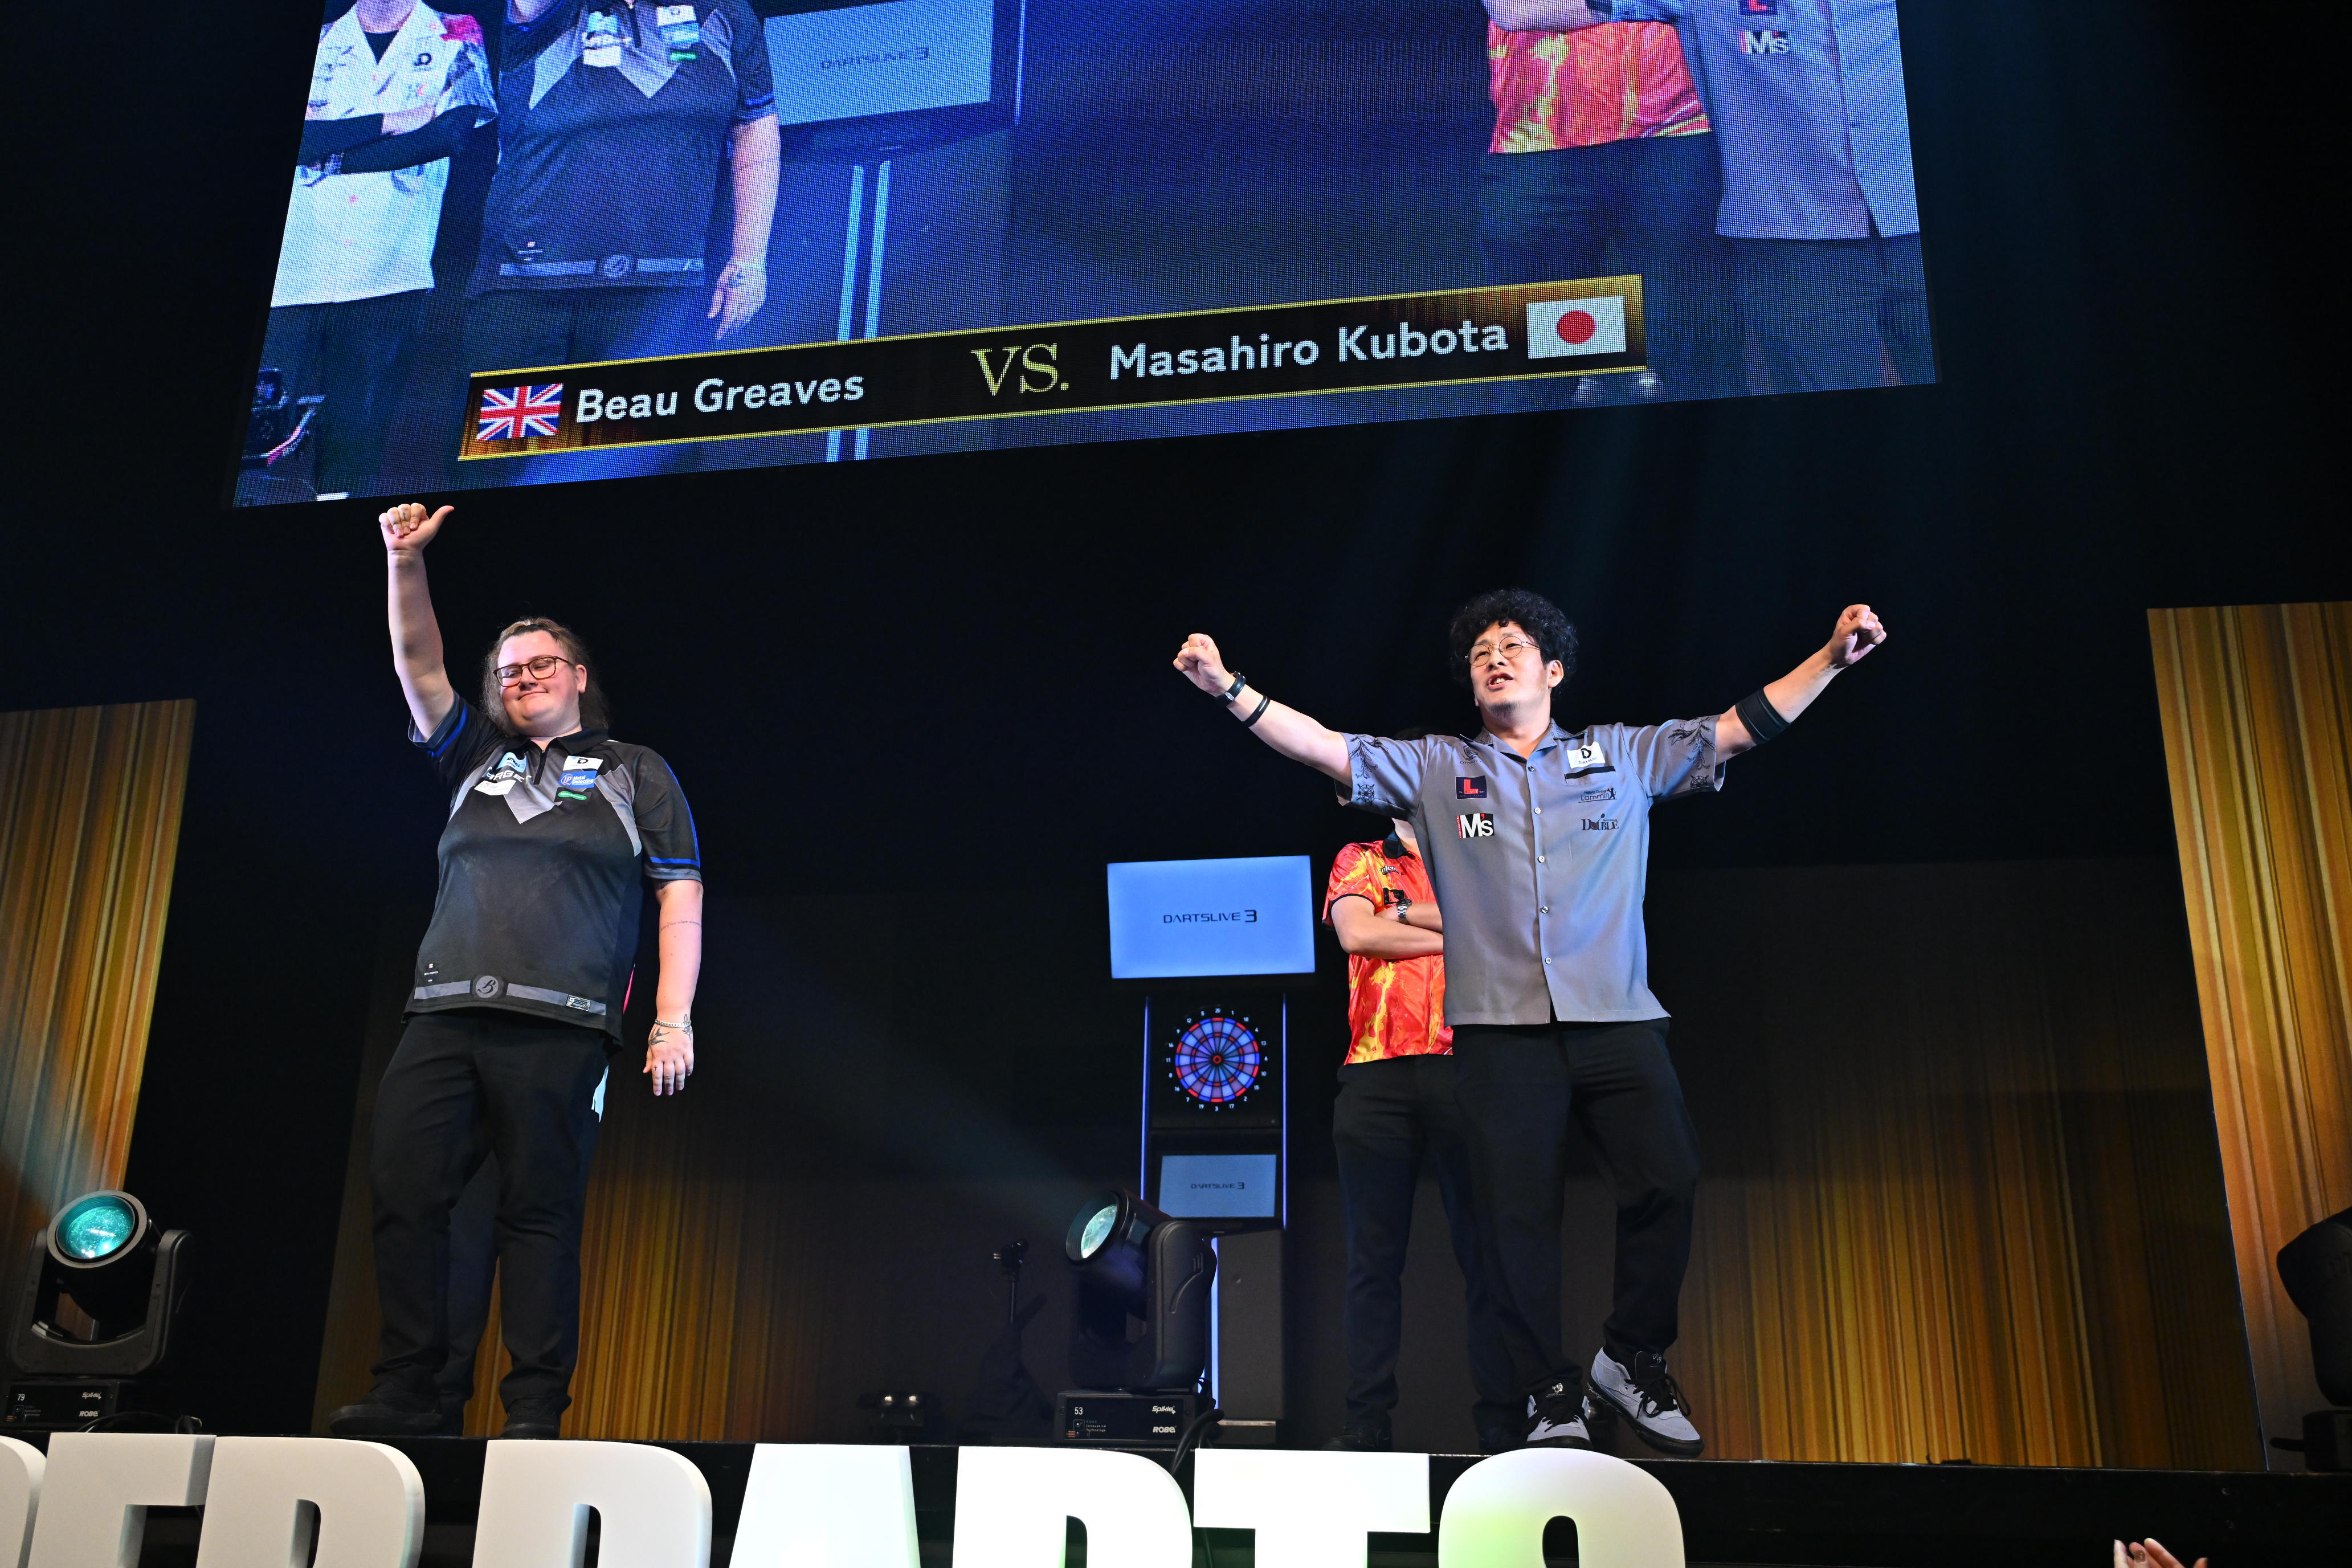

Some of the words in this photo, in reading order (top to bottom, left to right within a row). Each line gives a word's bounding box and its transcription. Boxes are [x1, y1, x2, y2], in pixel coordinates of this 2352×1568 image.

[971, 343, 1069, 397] VS.
[1110, 333, 1320, 380] Masahiro
[1338, 320, 1509, 362] Kubota
[575, 389, 678, 423] Beau
[693, 376, 864, 413] Greaves
[1460, 812, 1494, 839] M's
[1163, 912, 1240, 923] DARTSLIVE
[1244, 909, 1257, 922] 3
